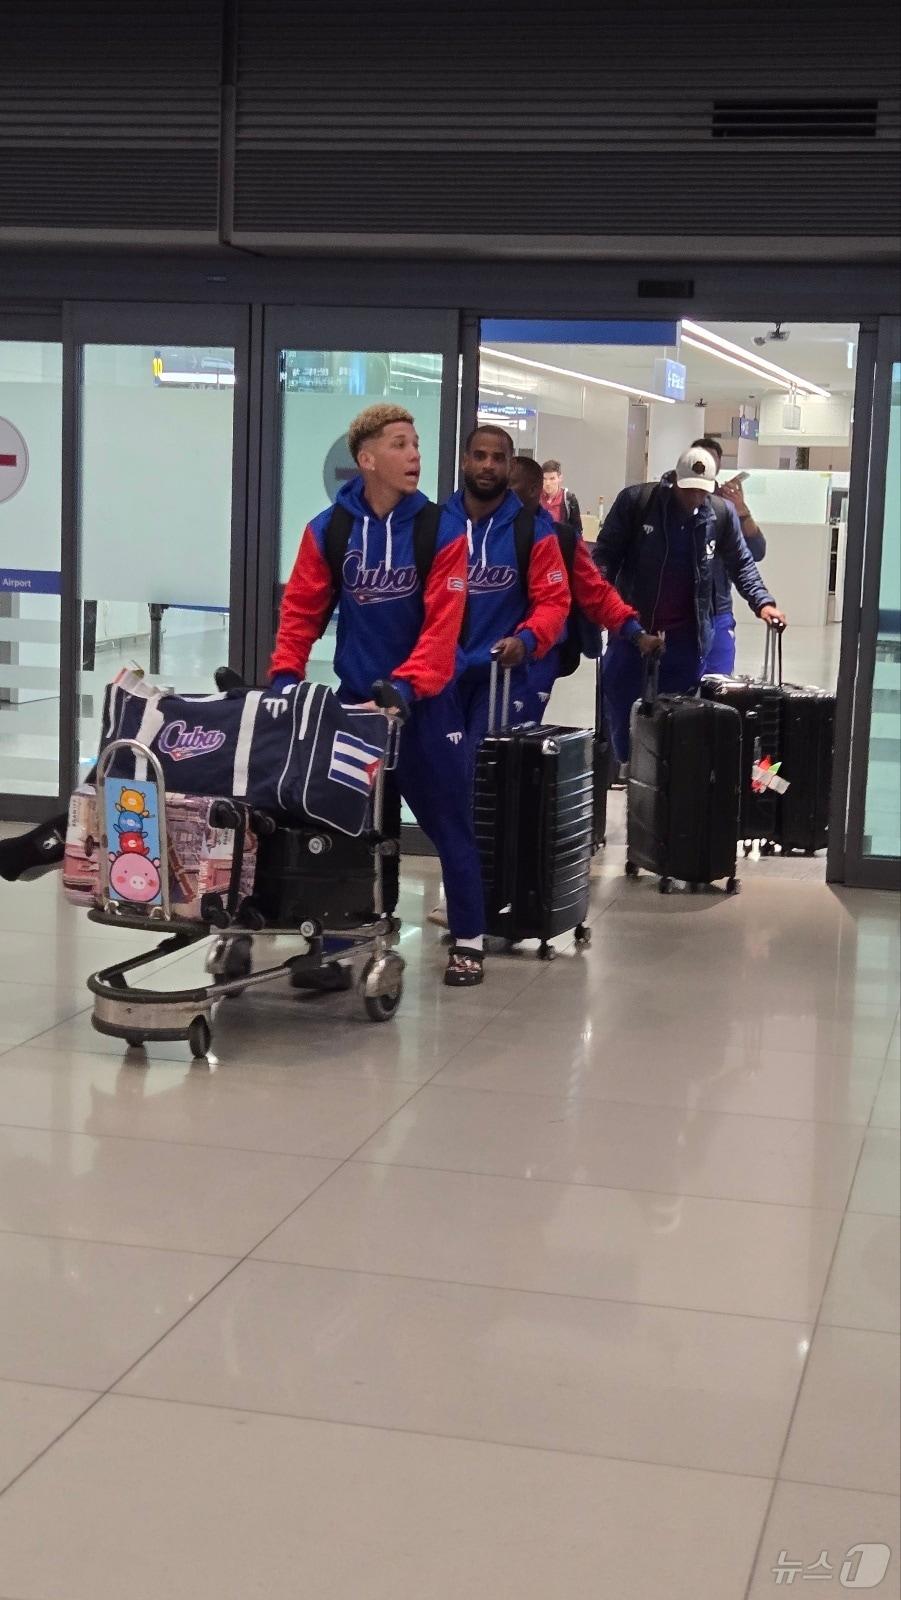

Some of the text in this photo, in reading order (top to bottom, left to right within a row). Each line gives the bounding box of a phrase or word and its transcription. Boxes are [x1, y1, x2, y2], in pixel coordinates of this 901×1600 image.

[2, 577, 32, 589] Airport
[341, 549, 420, 600] Cuba
[158, 720, 226, 758] Cuba
